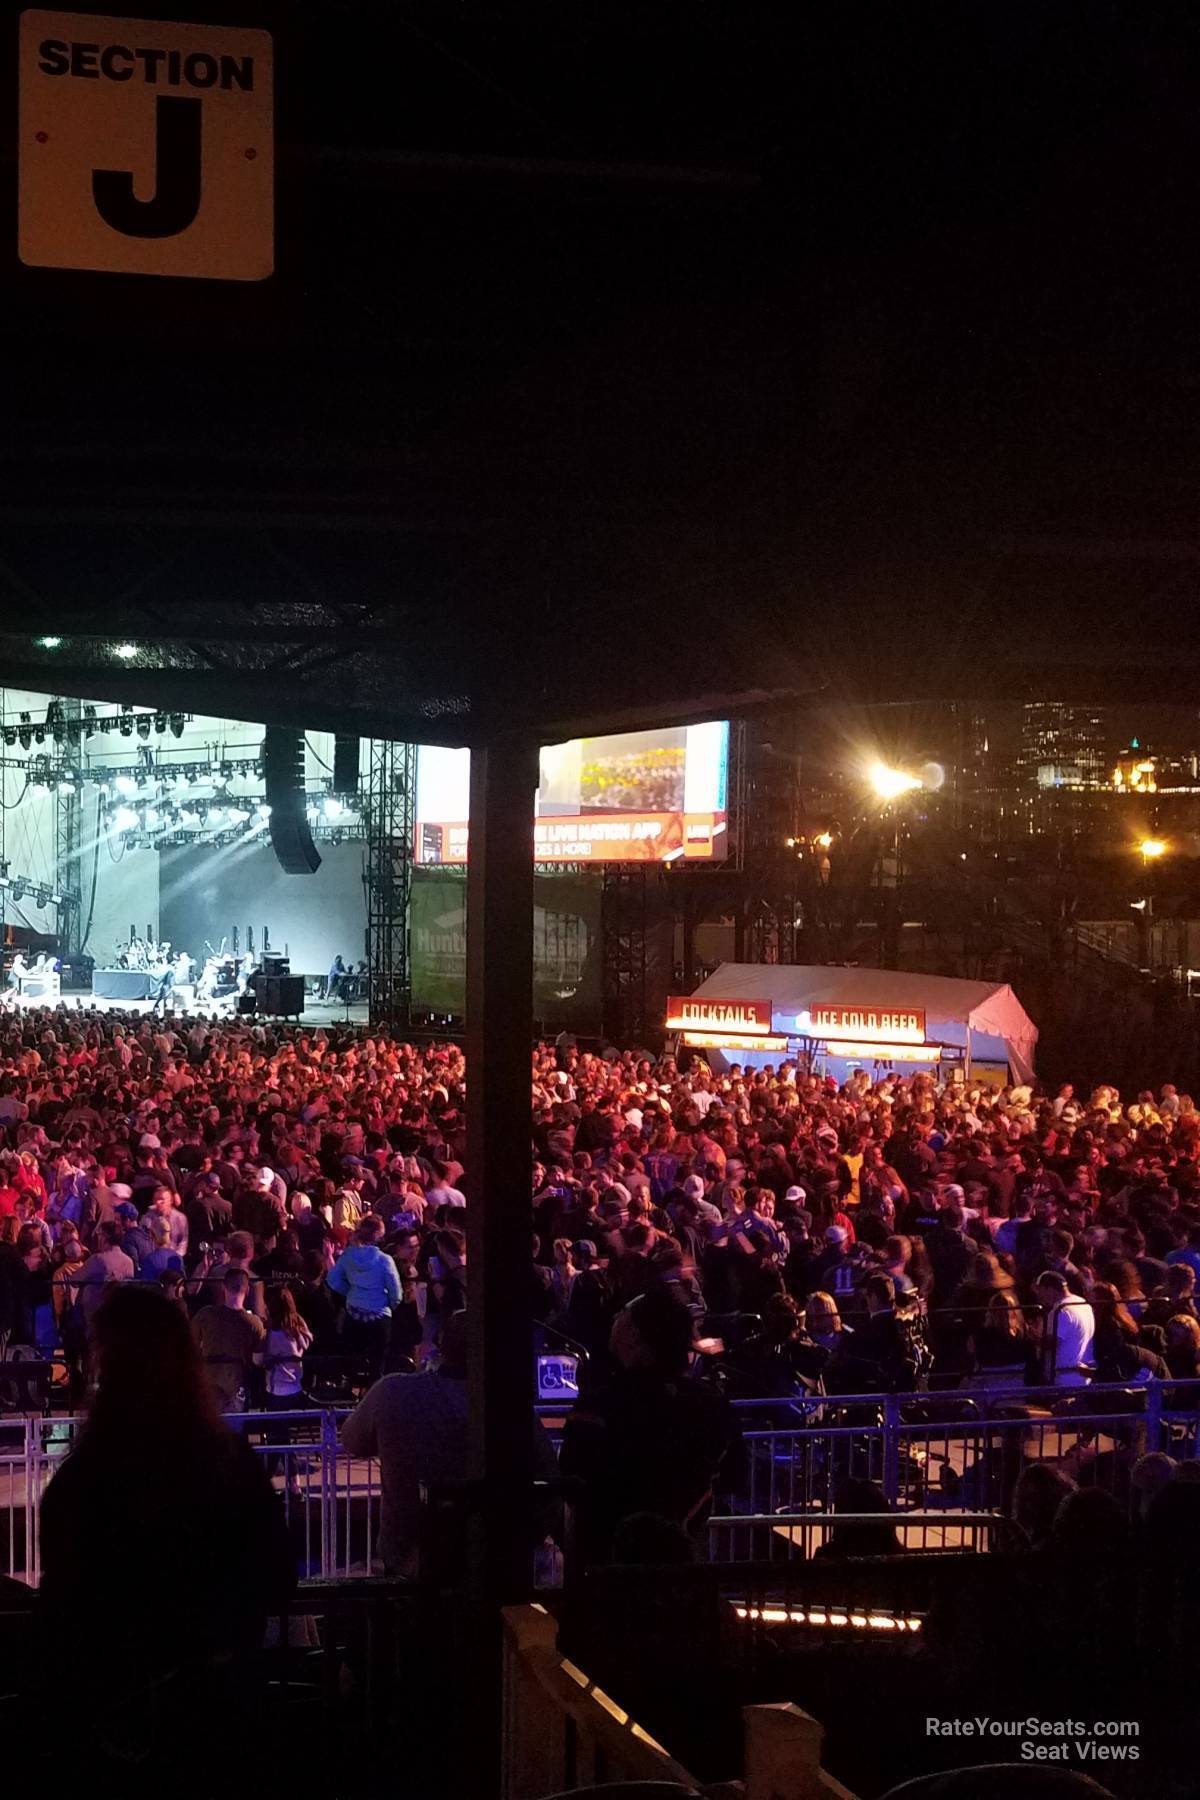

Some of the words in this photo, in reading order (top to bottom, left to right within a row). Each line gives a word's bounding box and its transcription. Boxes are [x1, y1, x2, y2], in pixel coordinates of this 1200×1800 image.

[38, 39, 254, 91] SECTION
[92, 95, 202, 239] J
[579, 823, 630, 841] NATION
[682, 1003, 756, 1025] COCKTAILS
[817, 1011, 837, 1027] ICE
[842, 1012, 877, 1029] COLD
[881, 1014, 918, 1031] BEER
